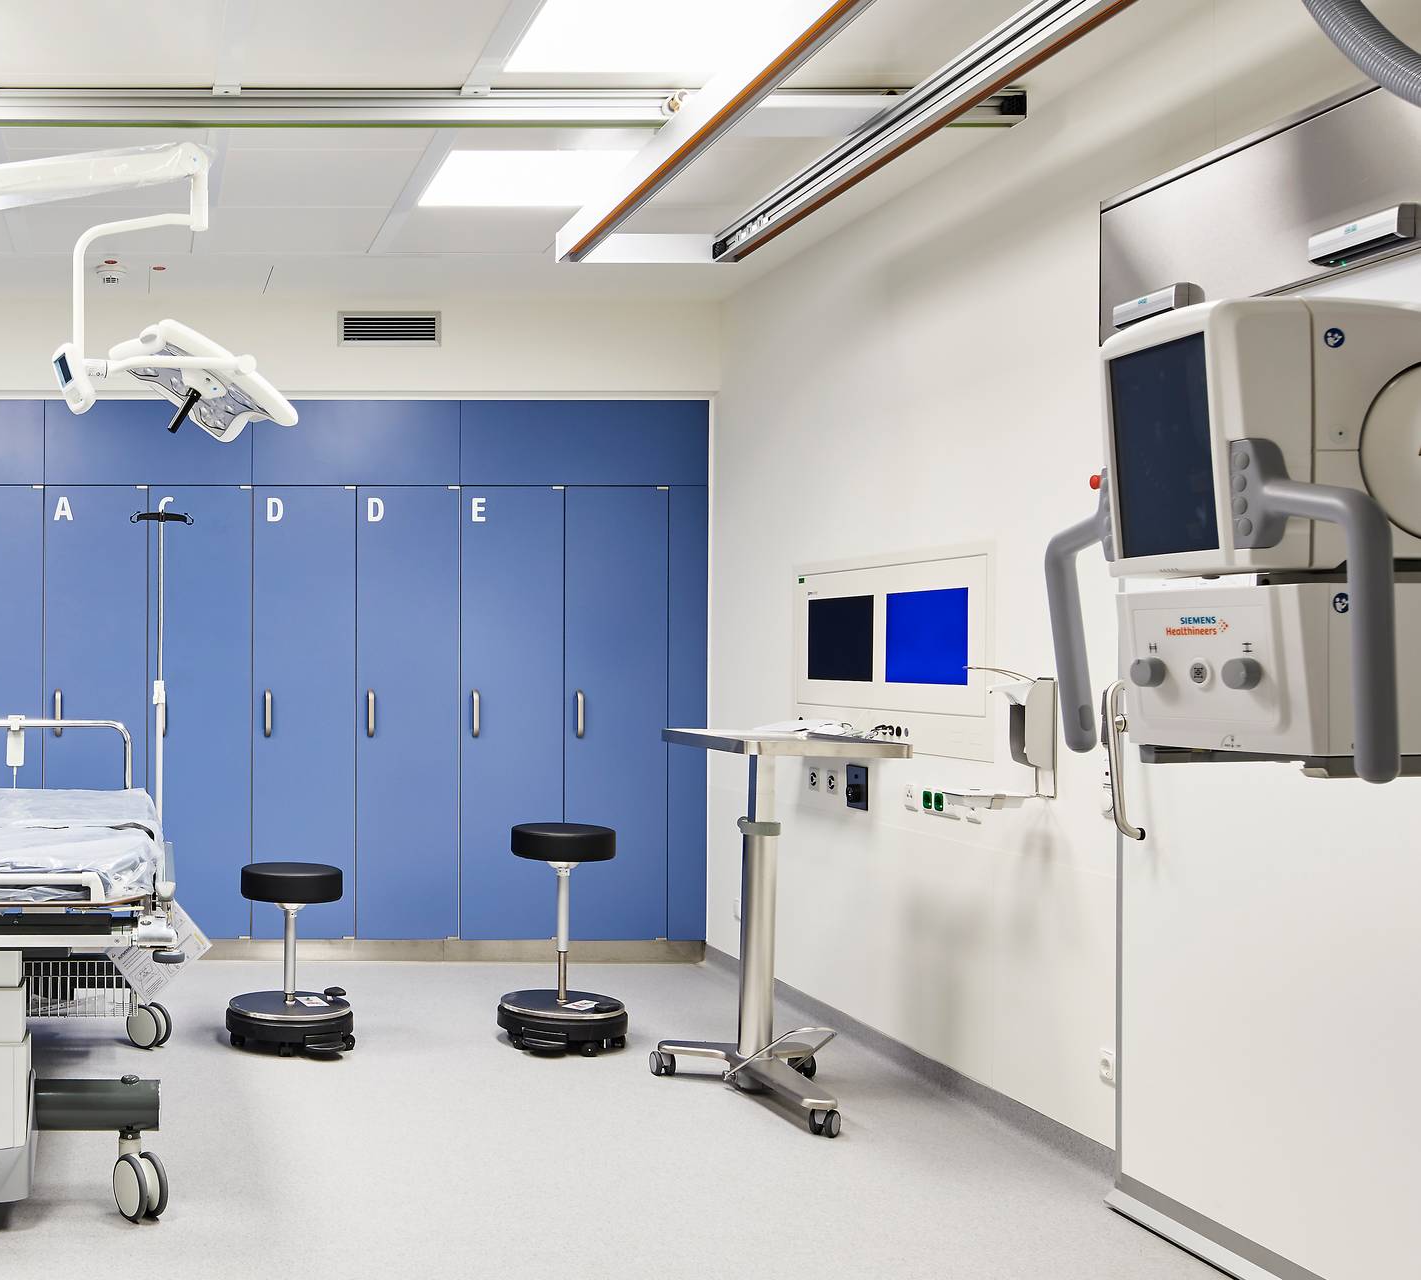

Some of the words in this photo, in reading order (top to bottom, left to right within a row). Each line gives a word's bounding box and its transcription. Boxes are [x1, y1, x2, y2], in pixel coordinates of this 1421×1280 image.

[54, 497, 73, 521] A
[267, 497, 283, 522] D
[368, 497, 384, 522] D
[472, 497, 485, 522] E
[1166, 626, 1218, 636] Healthineers
[1180, 616, 1216, 625] SIEMENS
